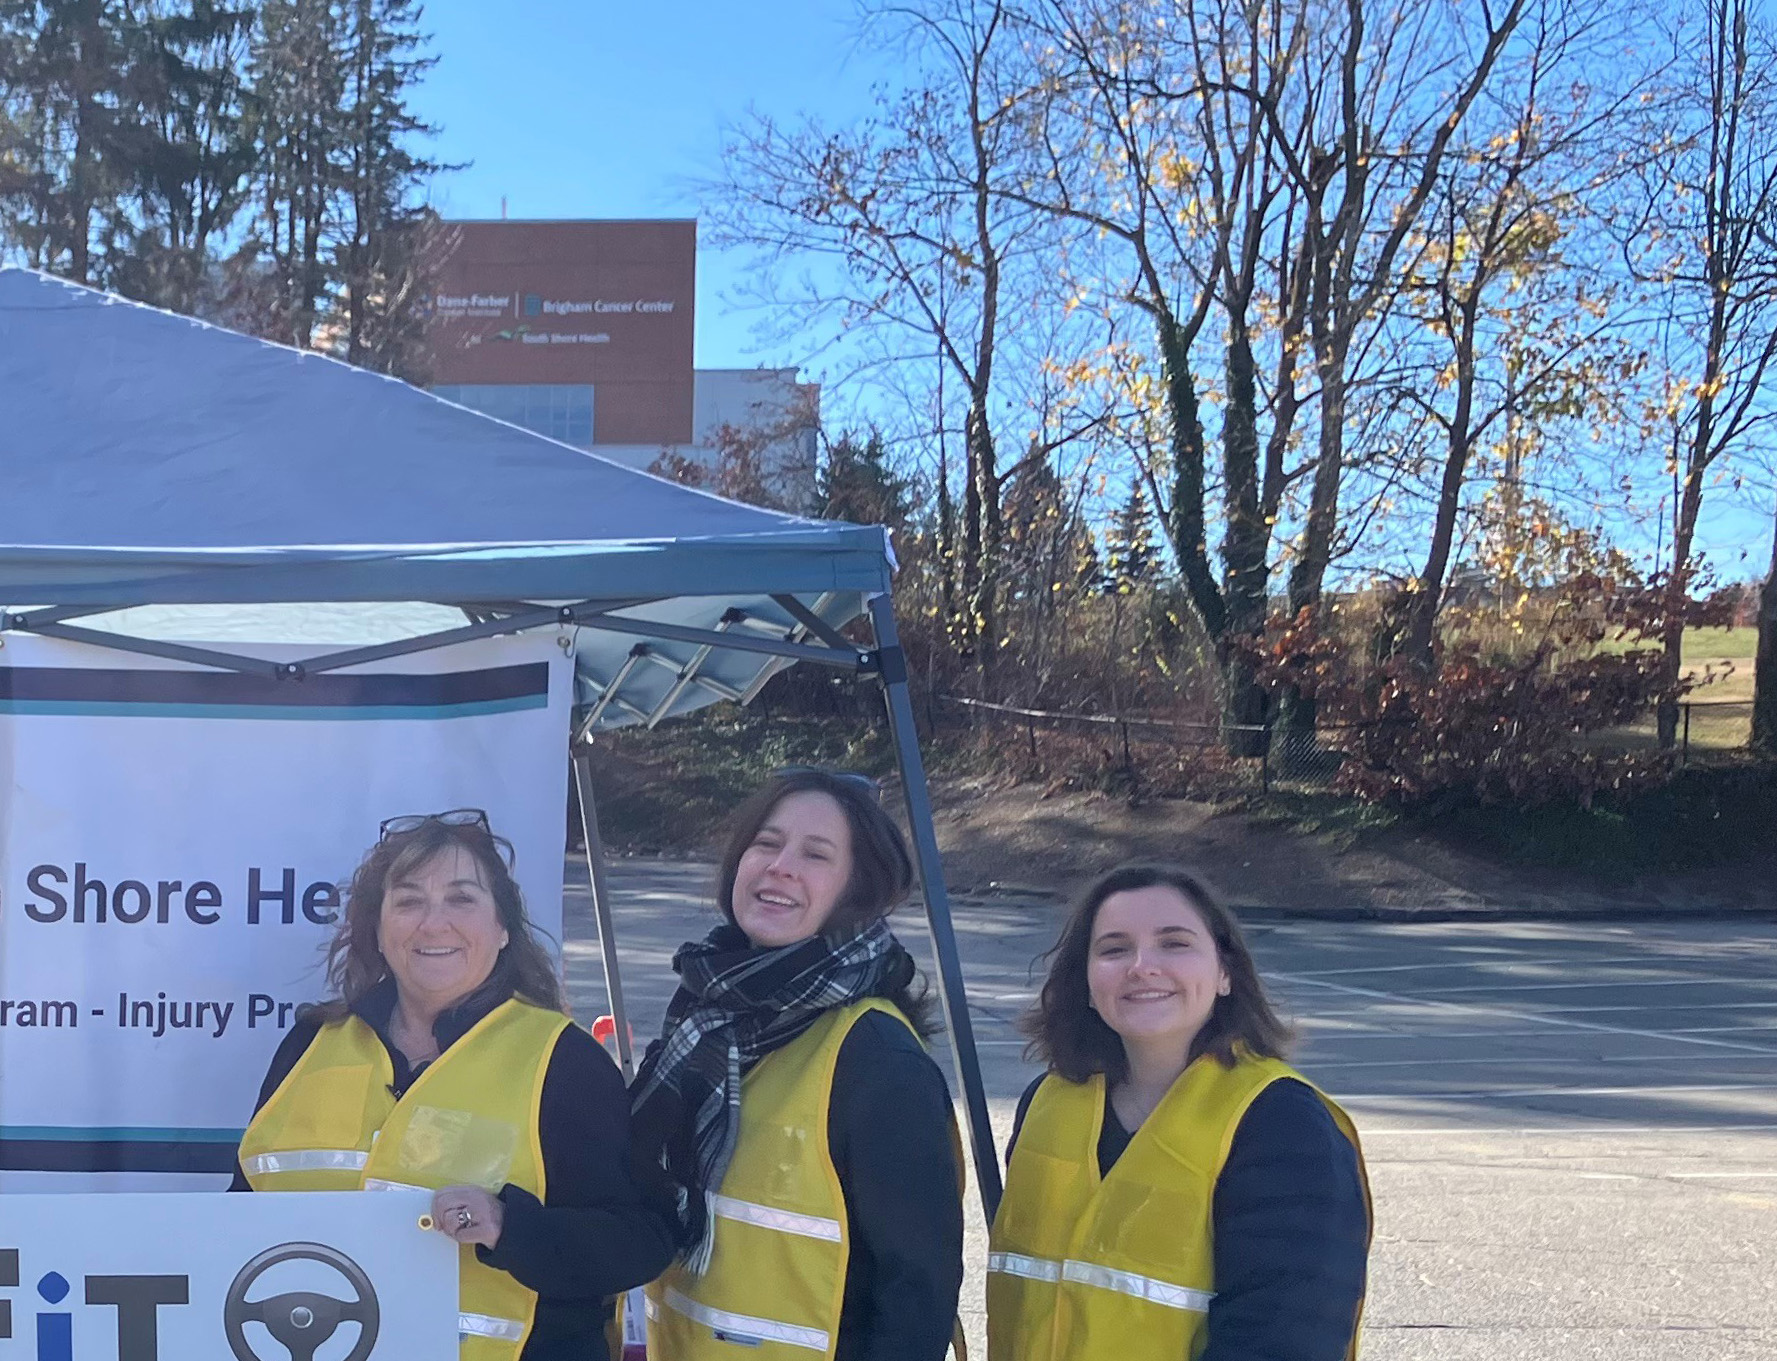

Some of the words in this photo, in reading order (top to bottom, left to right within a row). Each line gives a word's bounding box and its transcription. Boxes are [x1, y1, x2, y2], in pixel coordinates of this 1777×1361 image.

[543, 300, 592, 315] Brigham
[593, 299, 633, 313] Cancer
[635, 298, 673, 313] Center
[24, 862, 222, 924] Shore
[118, 992, 234, 1038] Injury
